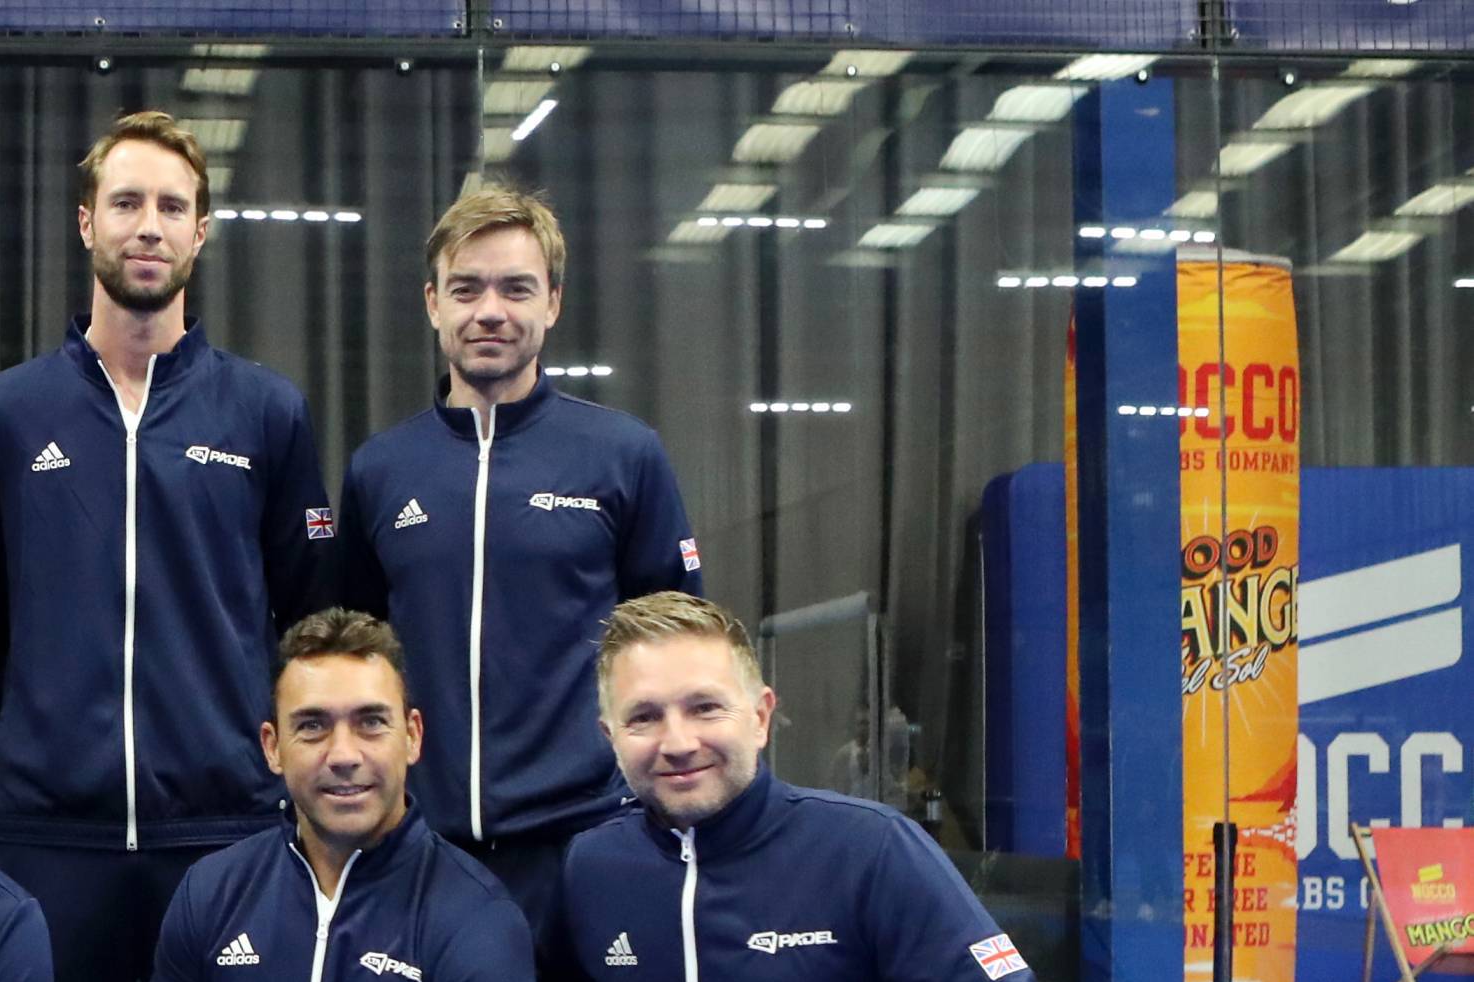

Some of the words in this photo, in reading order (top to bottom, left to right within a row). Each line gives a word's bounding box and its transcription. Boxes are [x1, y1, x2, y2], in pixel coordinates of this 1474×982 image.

[31, 457, 71, 472] adidas
[209, 450, 252, 470] PADEL
[555, 496, 601, 511] PADEL
[394, 513, 429, 529] adidas
[1182, 566, 1298, 658] ANG
[1182, 658, 1213, 694] el
[1211, 643, 1271, 690] Sol
[778, 930, 838, 948] PADEL
[216, 953, 260, 966] adidas
[605, 955, 638, 966] adidas
